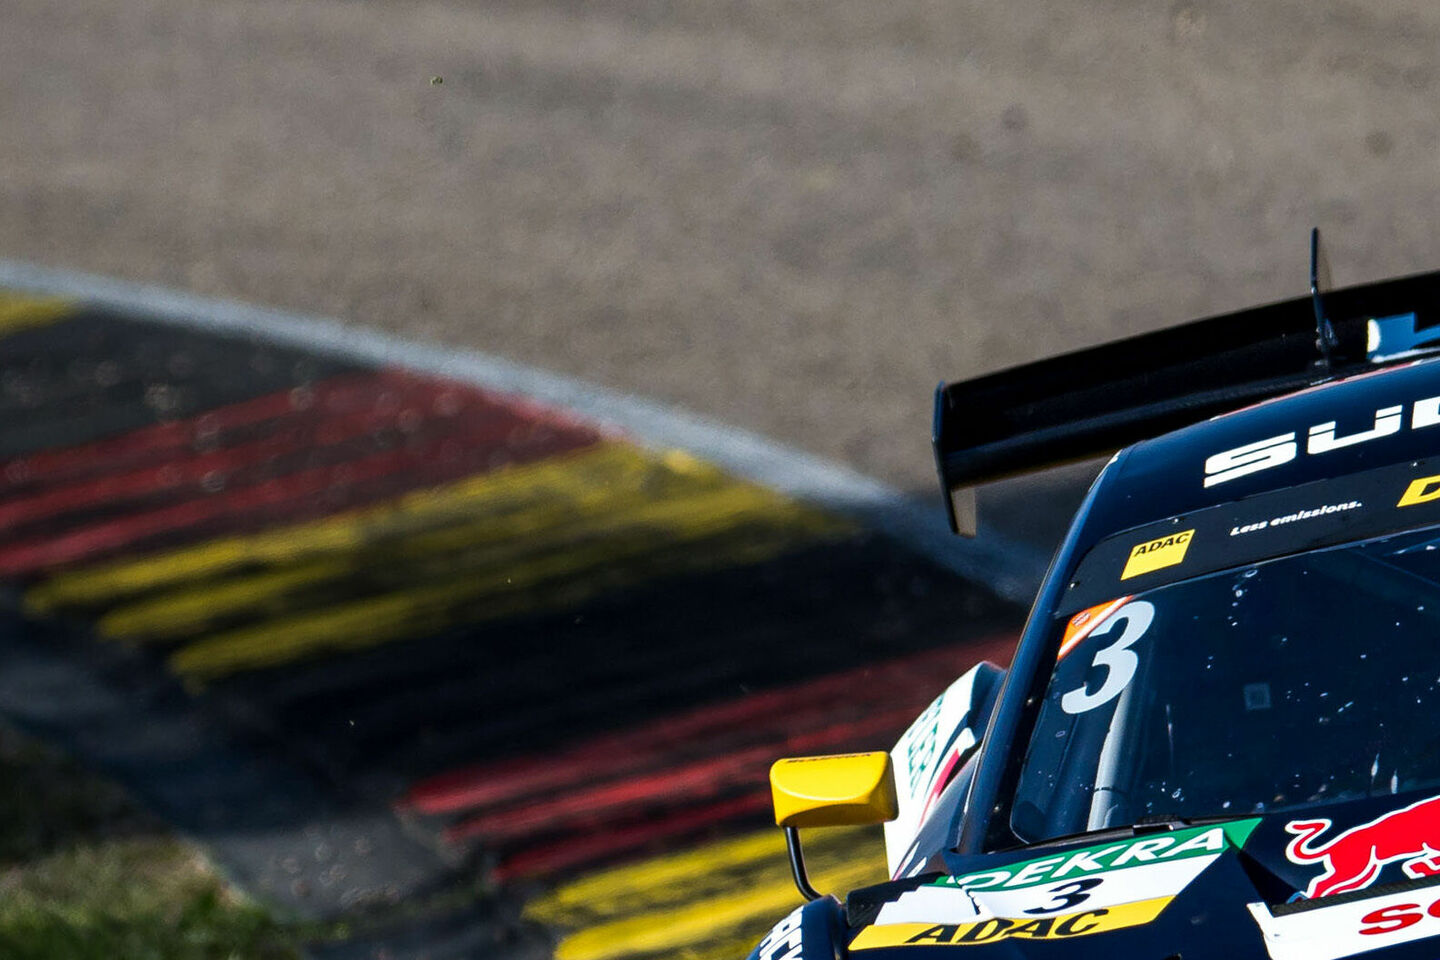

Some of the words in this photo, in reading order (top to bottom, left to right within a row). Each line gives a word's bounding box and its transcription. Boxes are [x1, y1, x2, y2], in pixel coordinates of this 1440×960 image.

[1134, 533, 1190, 557] ADAC
[1230, 521, 1269, 536] Less
[1061, 600, 1155, 714] 3
[945, 827, 1225, 890] DEKRA
[1023, 878, 1104, 915] 3
[903, 908, 1109, 946] ADAC
